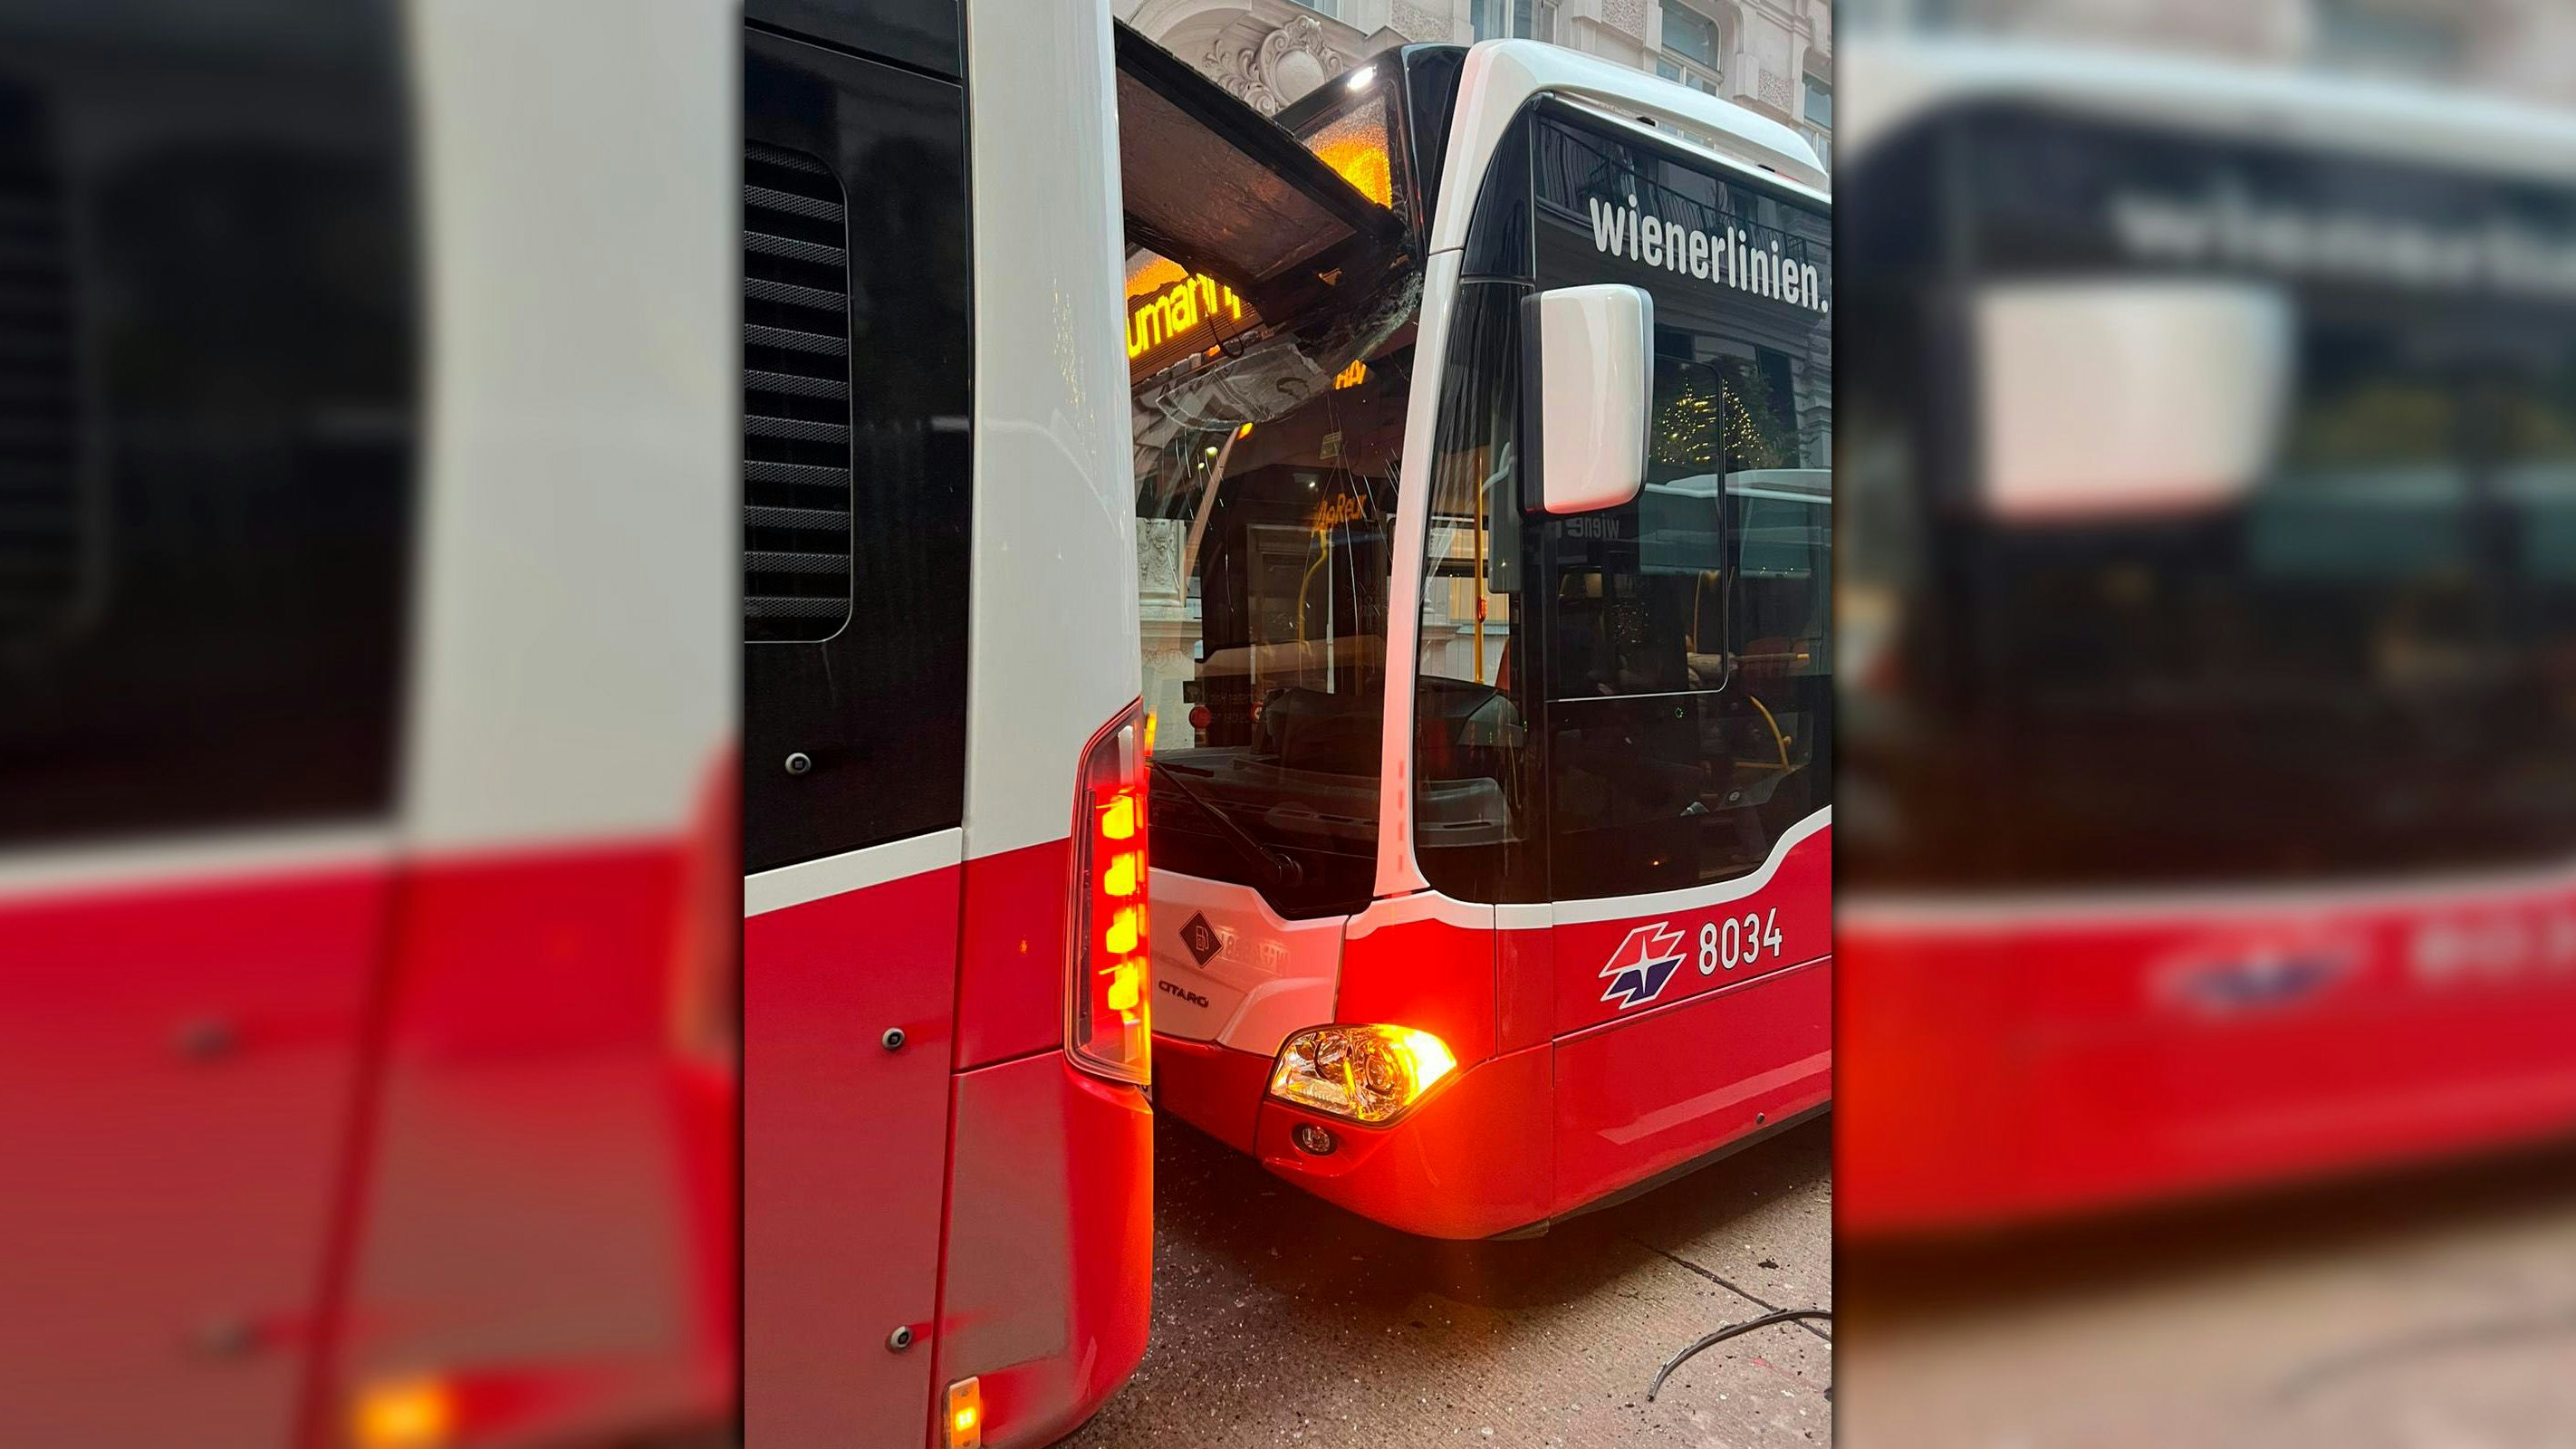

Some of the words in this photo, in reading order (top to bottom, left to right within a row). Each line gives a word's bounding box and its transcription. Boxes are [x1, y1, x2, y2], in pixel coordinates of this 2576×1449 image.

[1590, 194, 1829, 313] wienerlinien.
[1698, 907, 1783, 975] 8034
[1158, 980, 1209, 1008] CITARO
